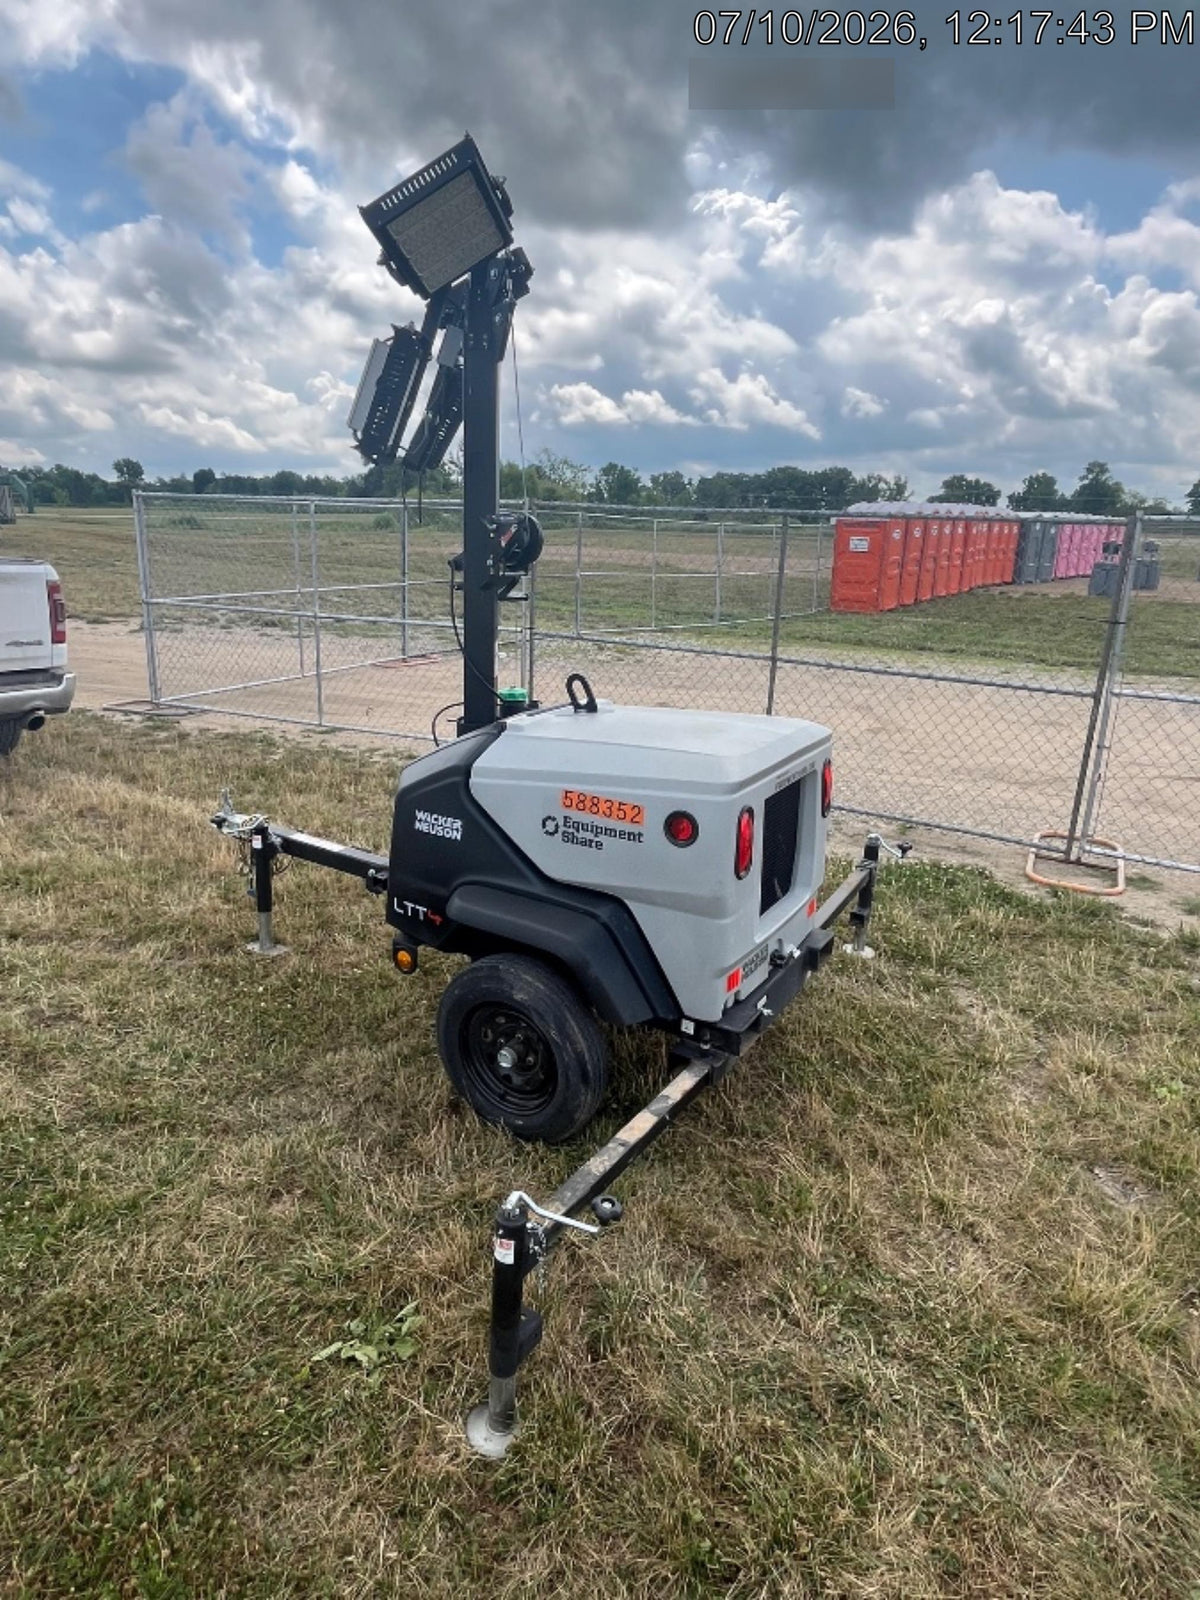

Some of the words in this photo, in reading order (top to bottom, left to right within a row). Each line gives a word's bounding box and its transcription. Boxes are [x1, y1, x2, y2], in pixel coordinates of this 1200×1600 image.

[563, 790, 641, 824] 588352
[415, 809, 462, 831] WACKER
[415, 819, 462, 841] NEUSON
[563, 815, 644, 843] Equipment
[561, 830, 604, 850] Share
